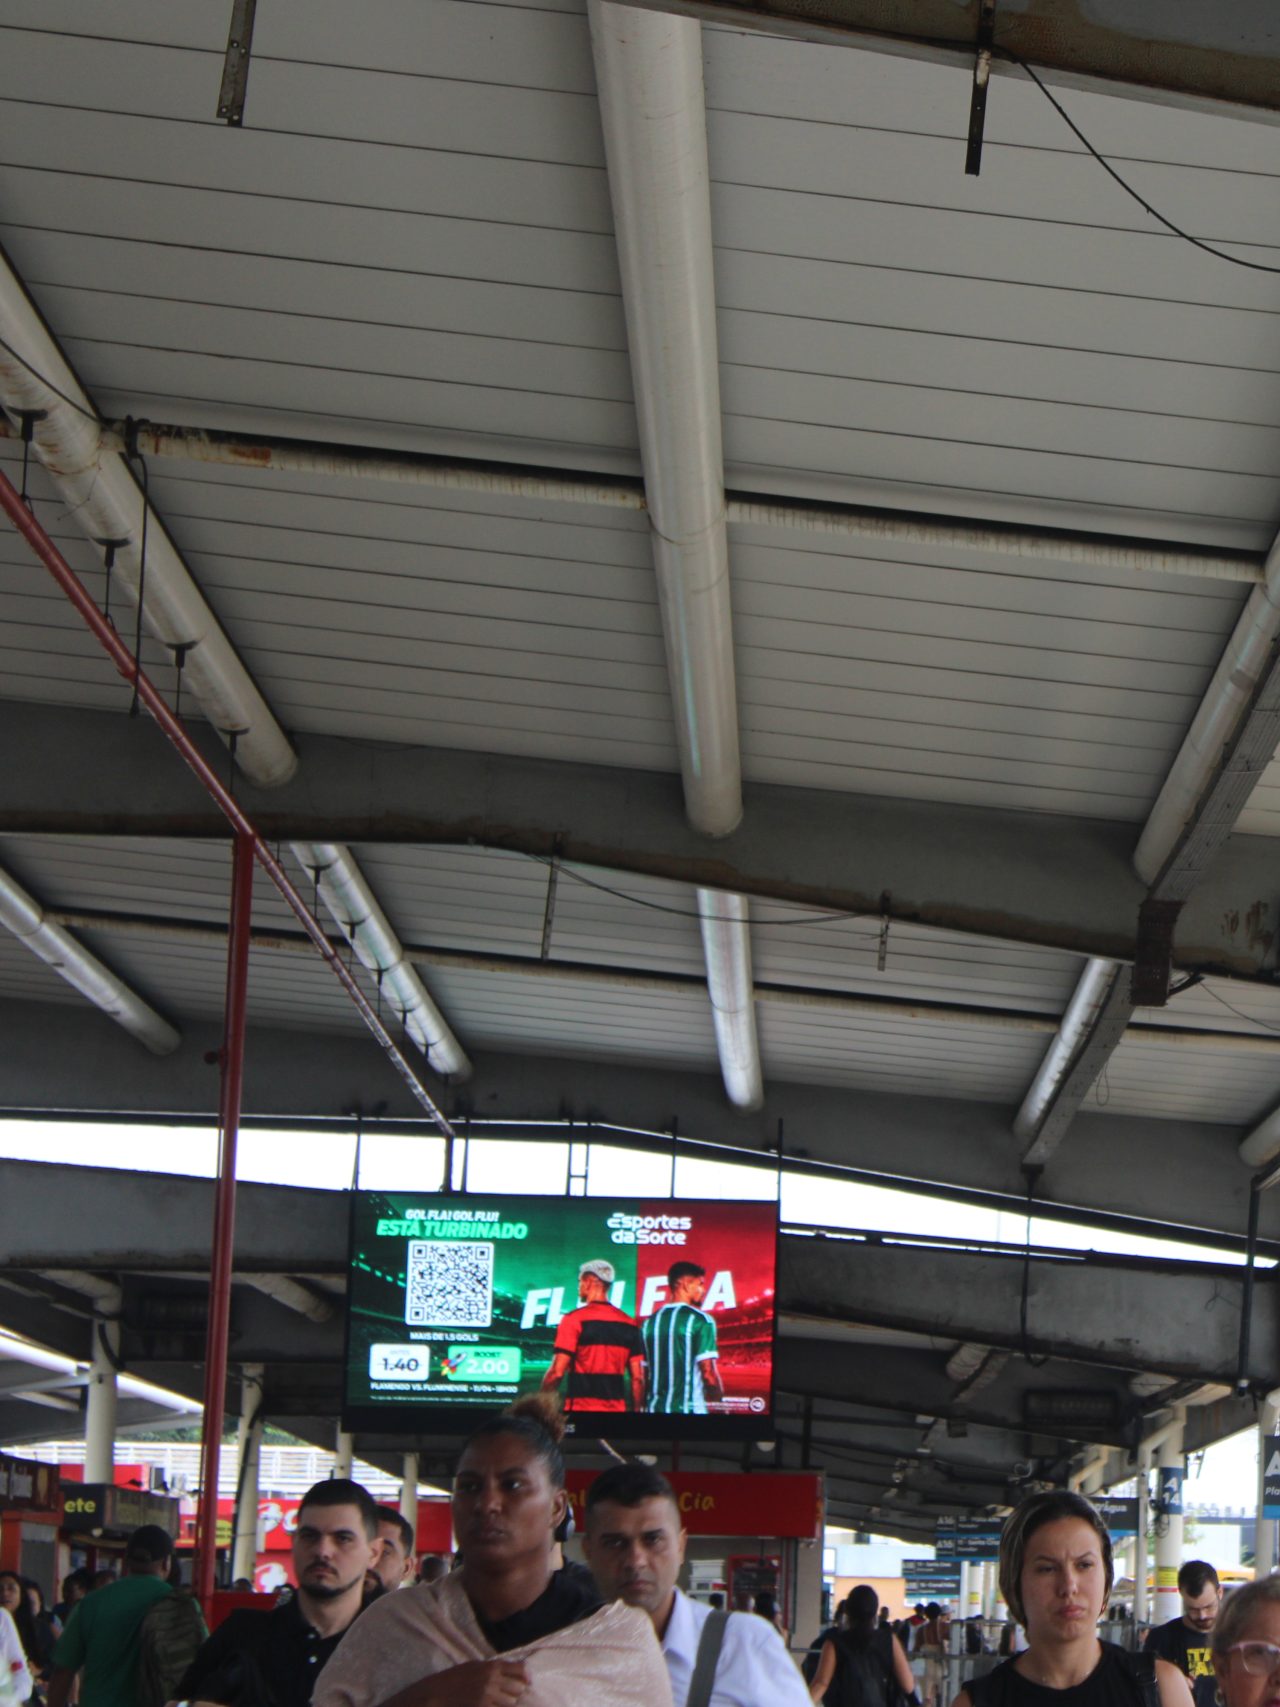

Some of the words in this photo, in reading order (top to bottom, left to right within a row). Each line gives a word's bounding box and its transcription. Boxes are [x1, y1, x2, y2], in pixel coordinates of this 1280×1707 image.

[405, 1209, 426, 1220] GOL
[427, 1209, 450, 1221] FLA!
[450, 1210, 474, 1222] GOL
[475, 1211, 500, 1222] FLU!
[607, 1212, 692, 1231] Esportes
[424, 1221, 528, 1239] TURBINADO
[639, 1271, 737, 1317] FA
[382, 1357, 419, 1371] 1.40
[466, 1359, 510, 1375] 2.00
[678, 1492, 715, 1512] Cia
